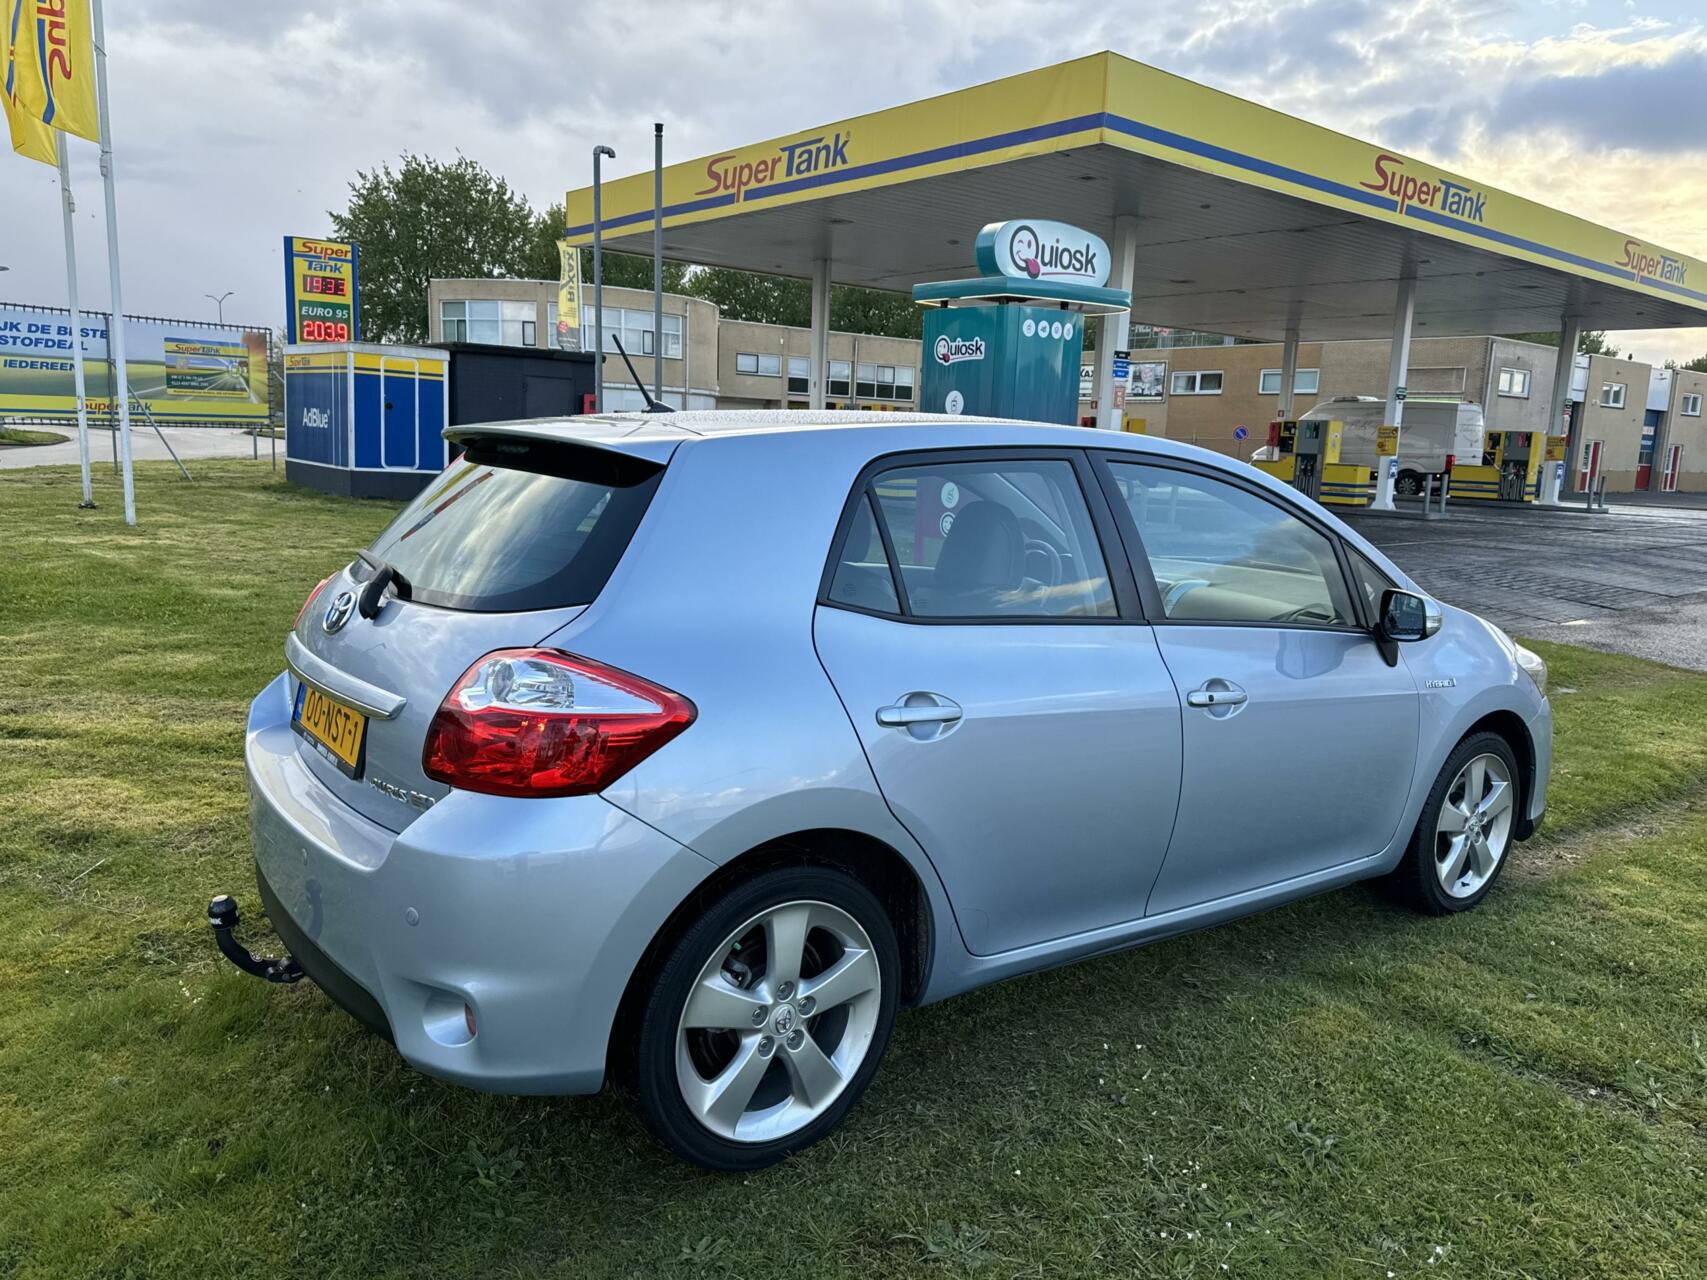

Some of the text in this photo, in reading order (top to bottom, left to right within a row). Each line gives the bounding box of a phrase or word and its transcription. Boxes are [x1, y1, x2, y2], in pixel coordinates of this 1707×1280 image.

[294, 241, 351, 260] Super
[1009, 225, 1096, 279] Quiosk
[303, 260, 343, 273] Tank
[301, 306, 348, 319] EURO 95
[27, 323, 52, 335] DE
[57, 326, 107, 339] BSTE
[936, 337, 983, 364] Quiosk
[302, 407, 329, 428] AdBlue
